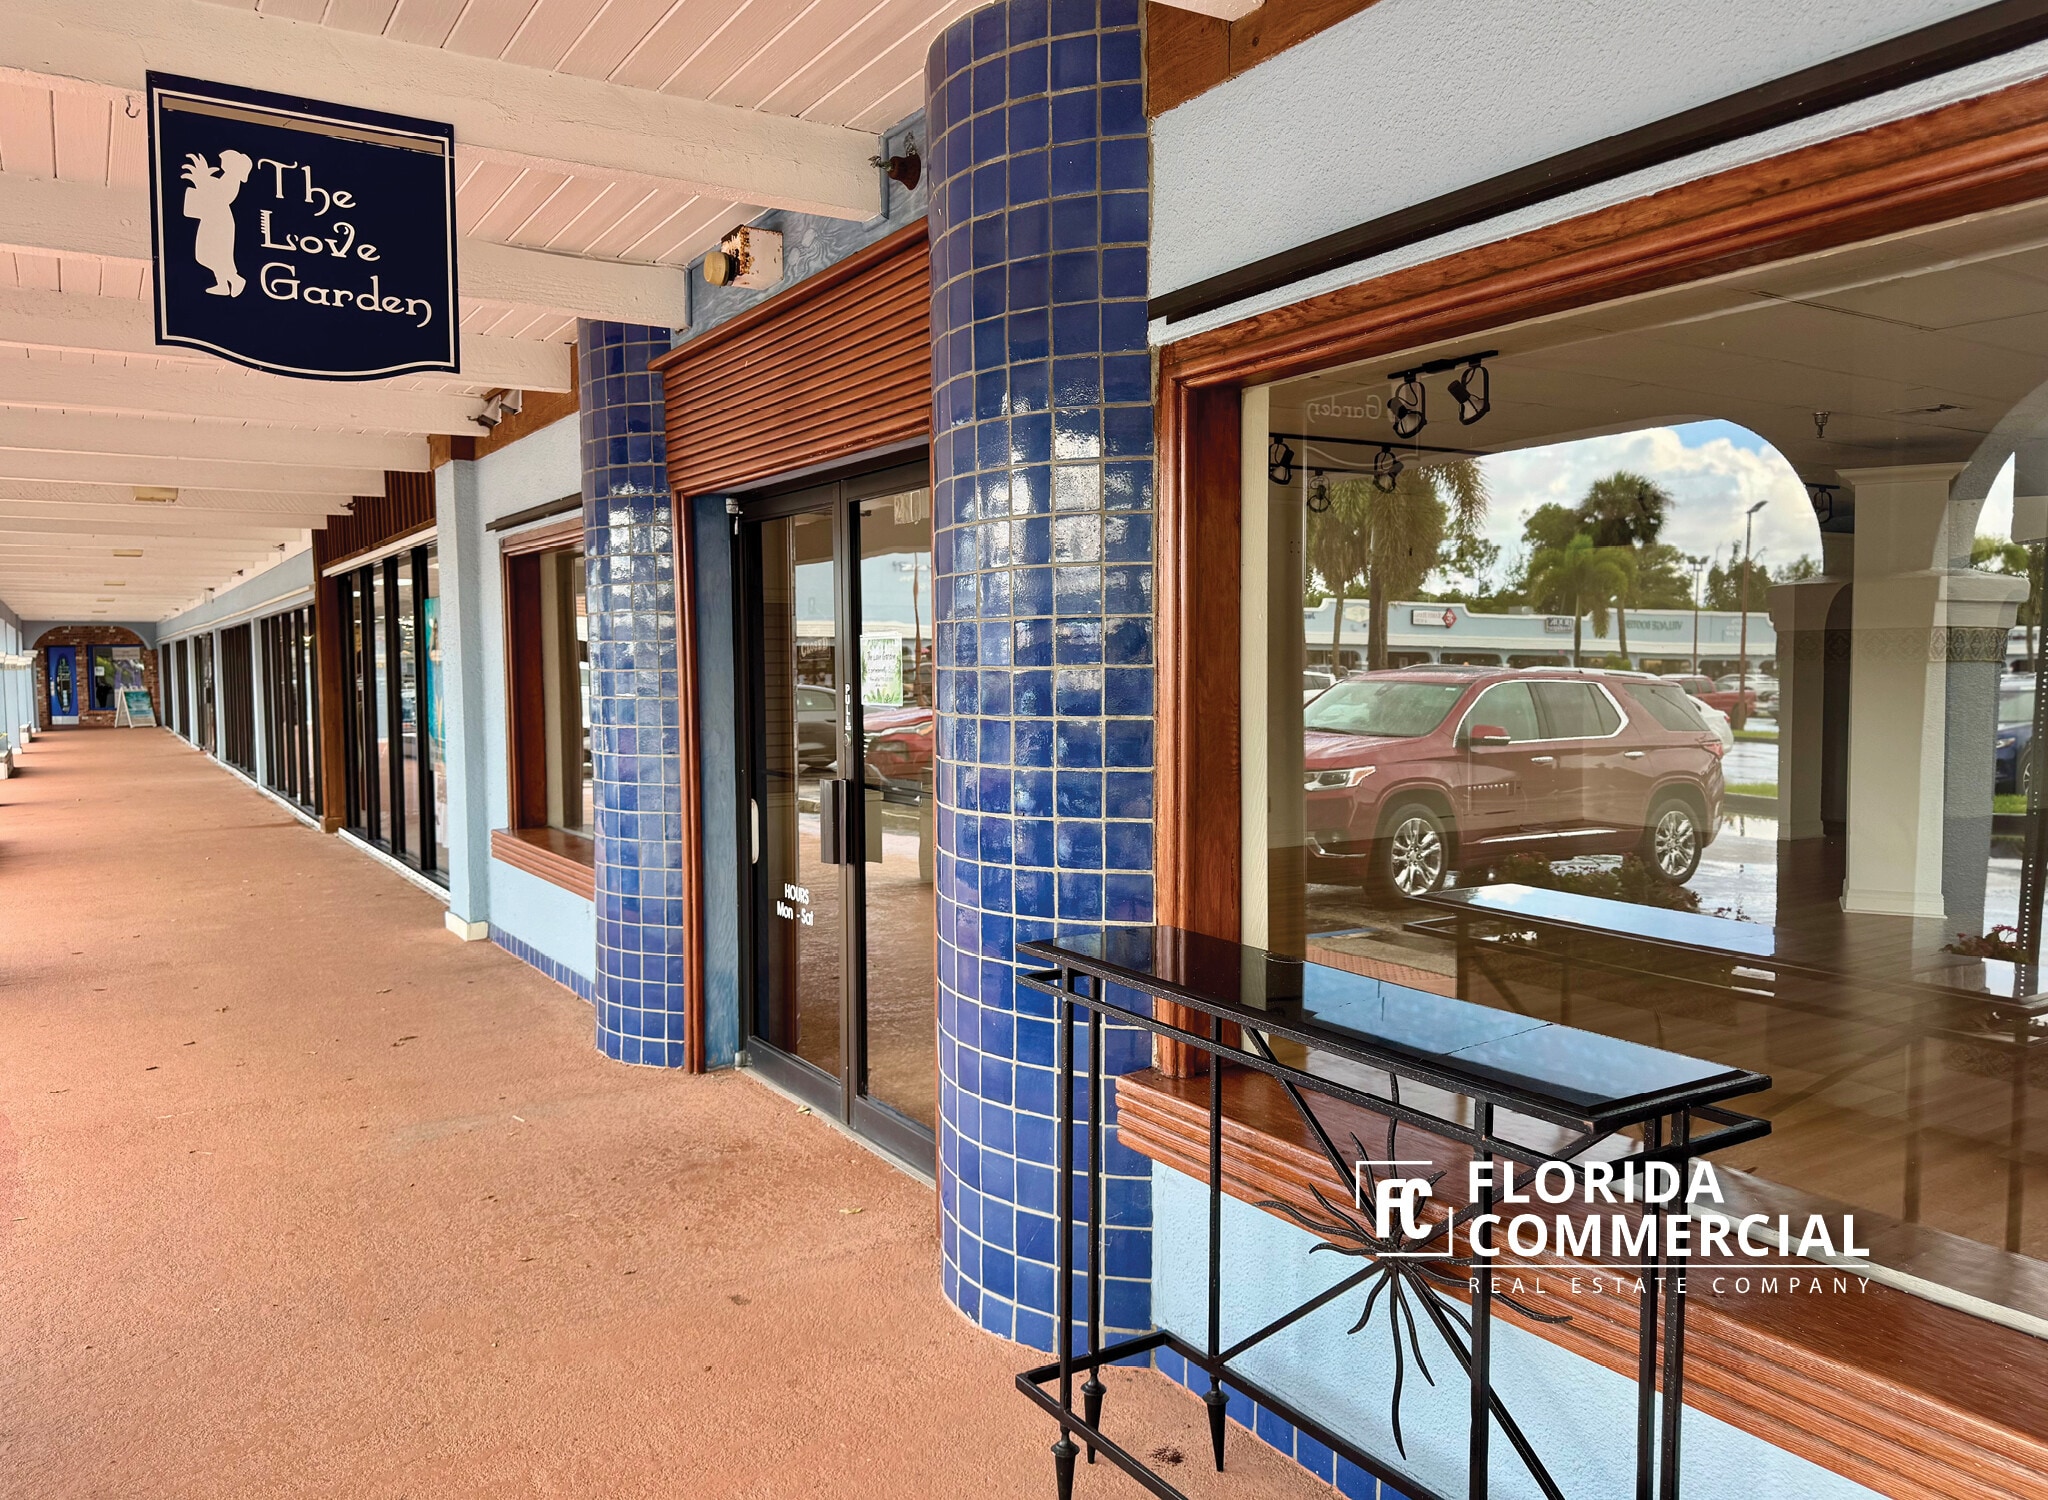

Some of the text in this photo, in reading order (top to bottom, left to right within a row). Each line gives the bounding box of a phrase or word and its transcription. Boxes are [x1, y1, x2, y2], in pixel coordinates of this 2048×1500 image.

[257, 158, 356, 216] The
[260, 209, 381, 262] Love
[260, 262, 432, 328] Garden
[776, 900, 793, 920] Mon
[801, 908, 814, 926] Sat
[784, 883, 809, 905] HOURS
